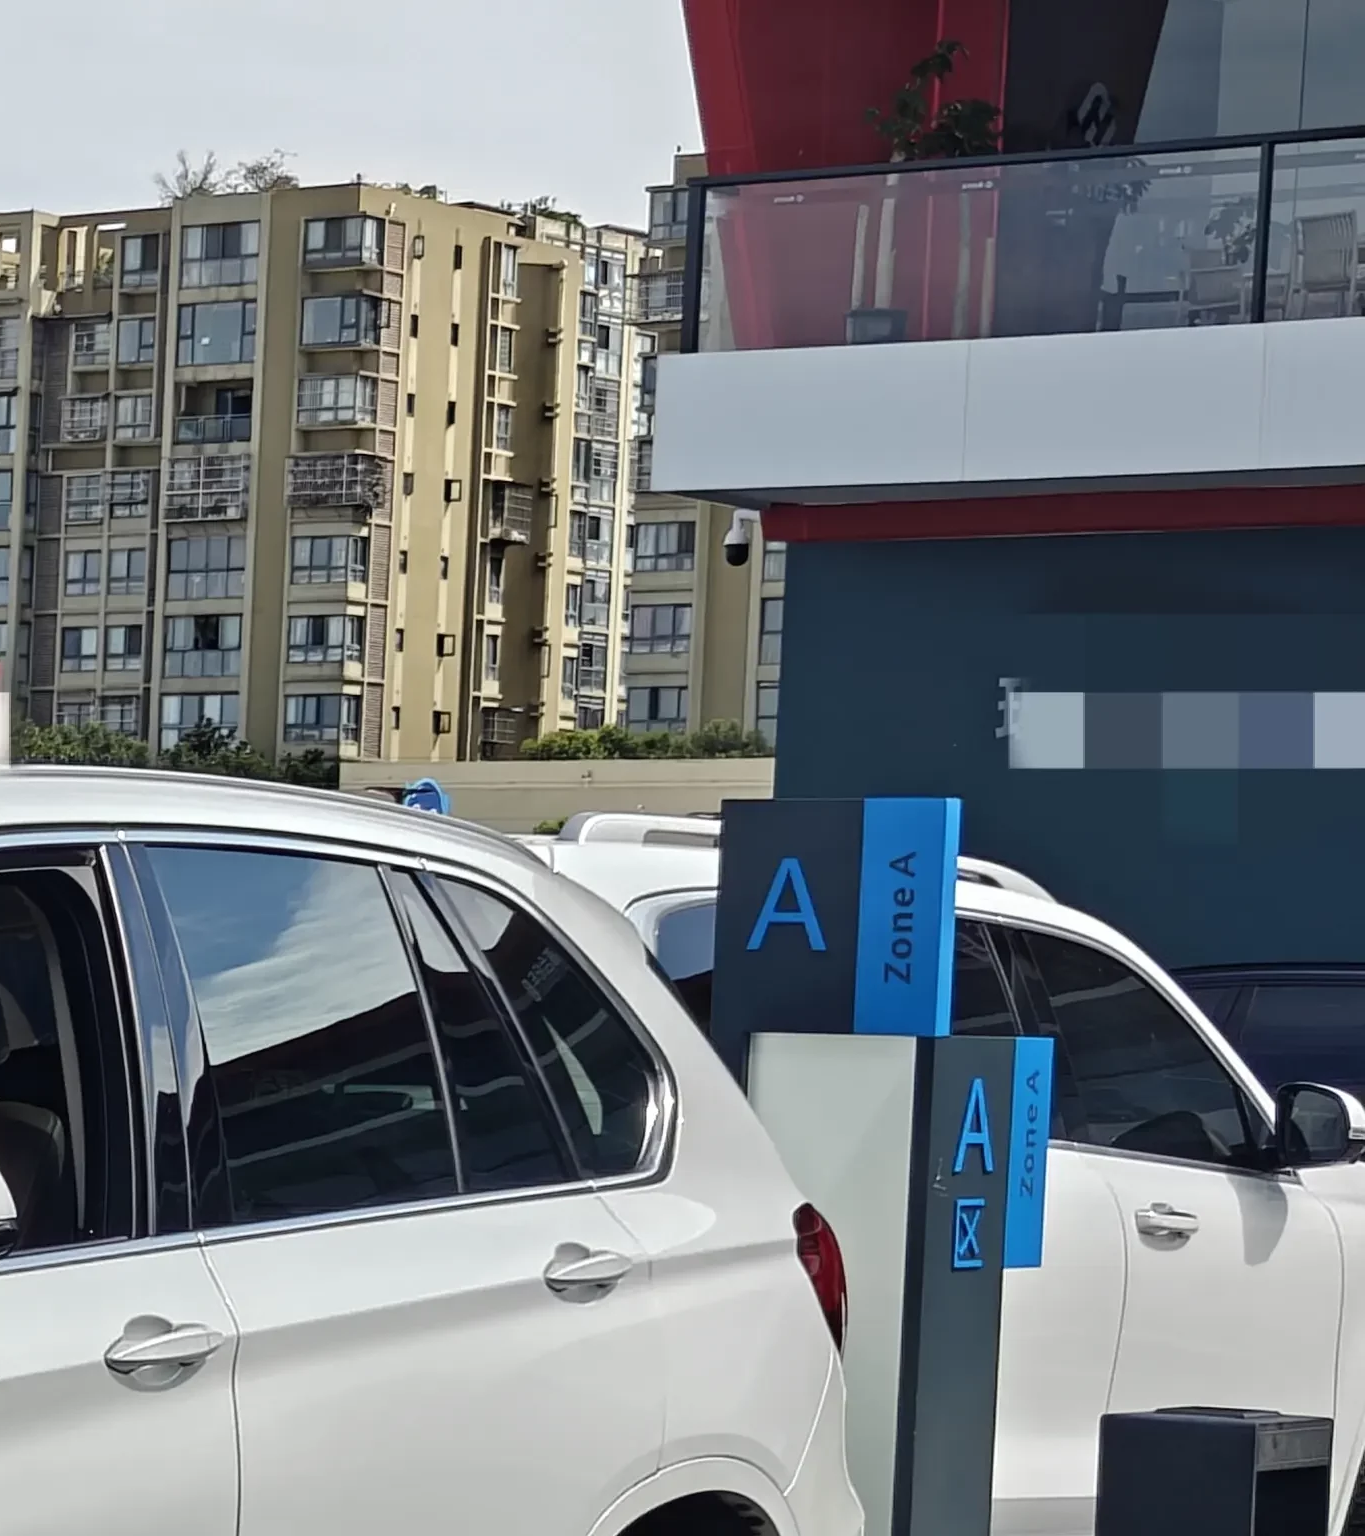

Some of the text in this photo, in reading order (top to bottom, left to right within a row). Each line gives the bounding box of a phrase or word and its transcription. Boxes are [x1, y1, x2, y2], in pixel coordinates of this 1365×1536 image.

[746, 857, 826, 951] A
[884, 851, 918, 984] Zone A
[1020, 1069, 1041, 1198] Zone A
